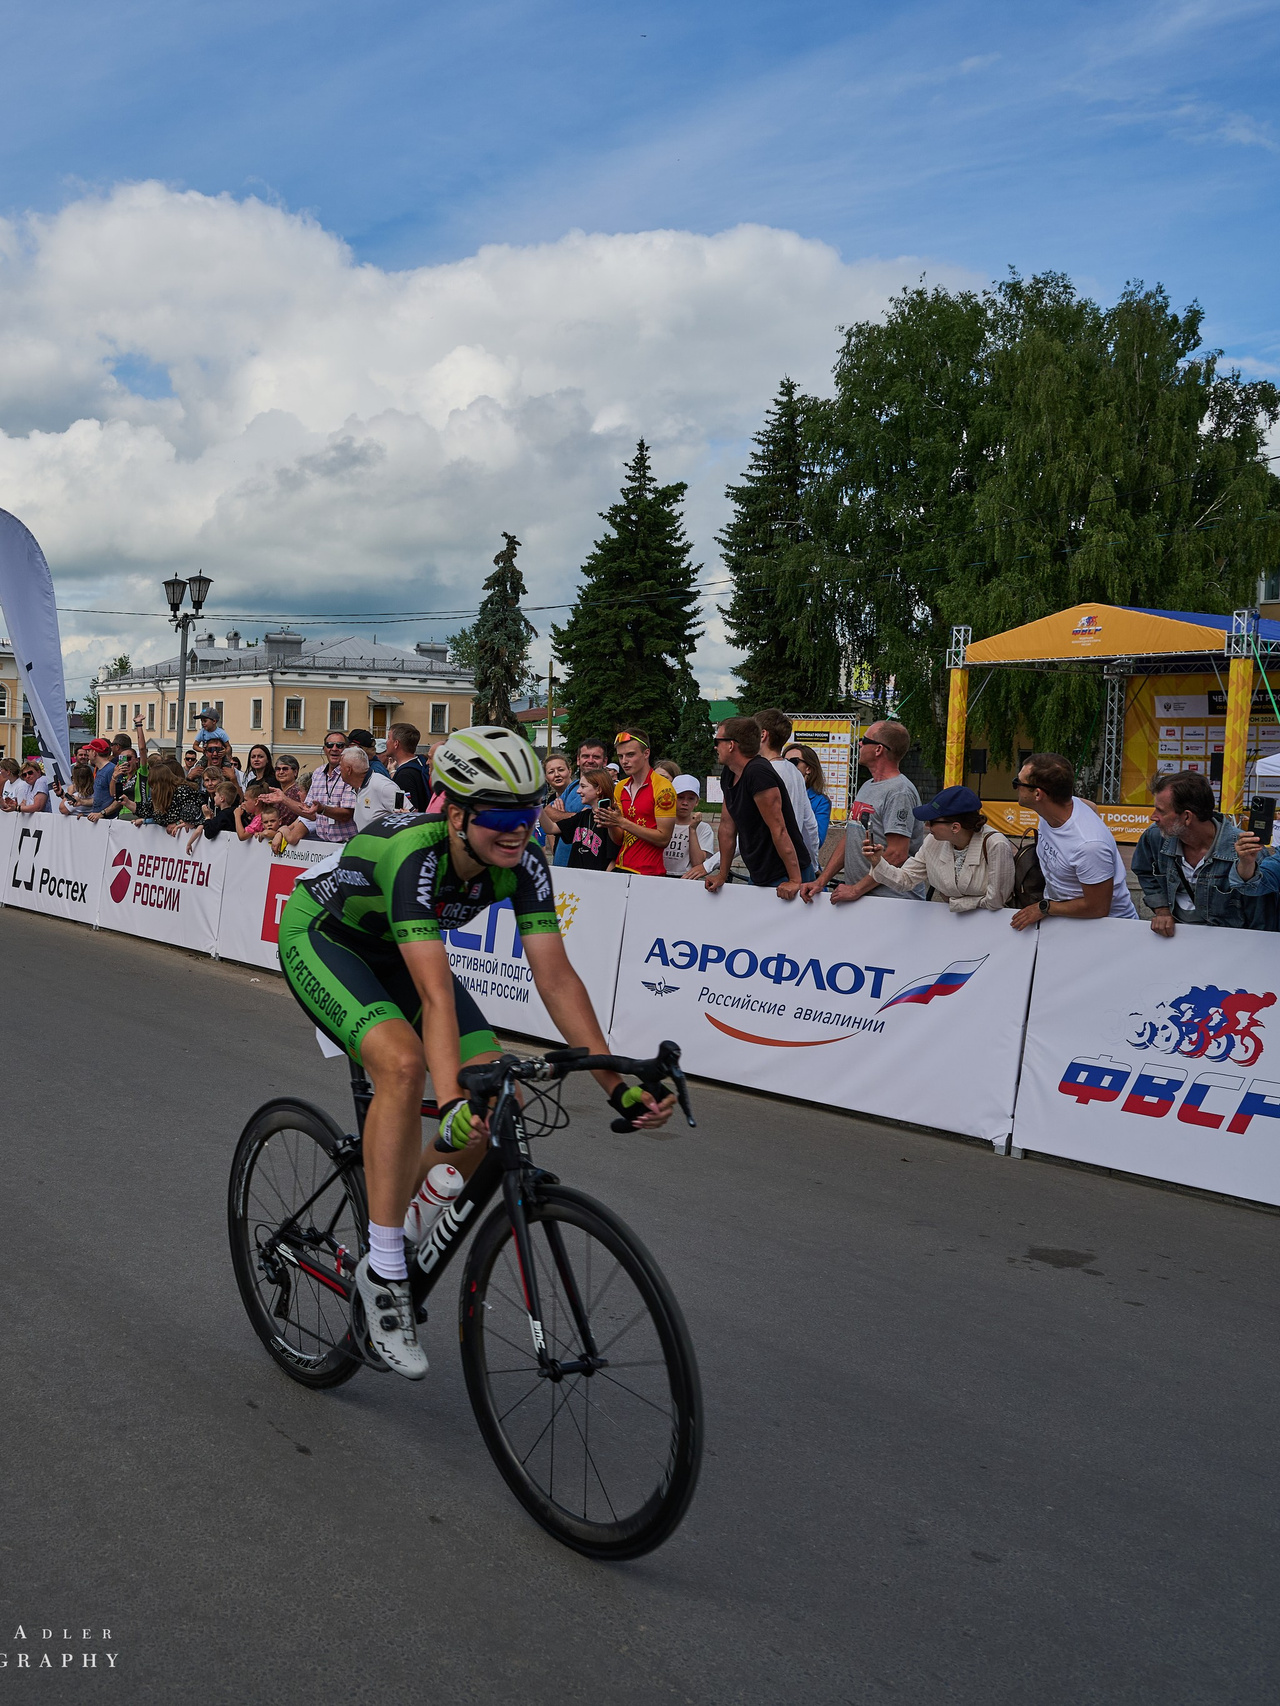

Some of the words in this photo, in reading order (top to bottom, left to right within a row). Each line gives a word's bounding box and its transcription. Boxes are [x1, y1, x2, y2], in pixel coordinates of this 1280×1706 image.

[1107, 813, 1150, 824] РОССИИ
[39, 868, 88, 904] Ростех
[136, 854, 212, 887] ВЕРТОЛЕТЫ
[132, 882, 181, 913] РОССИИ
[643, 937, 896, 1000] АЭРОФЛОТ
[454, 974, 489, 997] ОМАНД
[490, 983, 530, 1004] РОССИИ
[697, 986, 787, 1018] Российские
[793, 1007, 886, 1034] авиалинии
[1057, 1054, 1280, 1136] ФВСР
[417, 1199, 475, 1274] BMC
